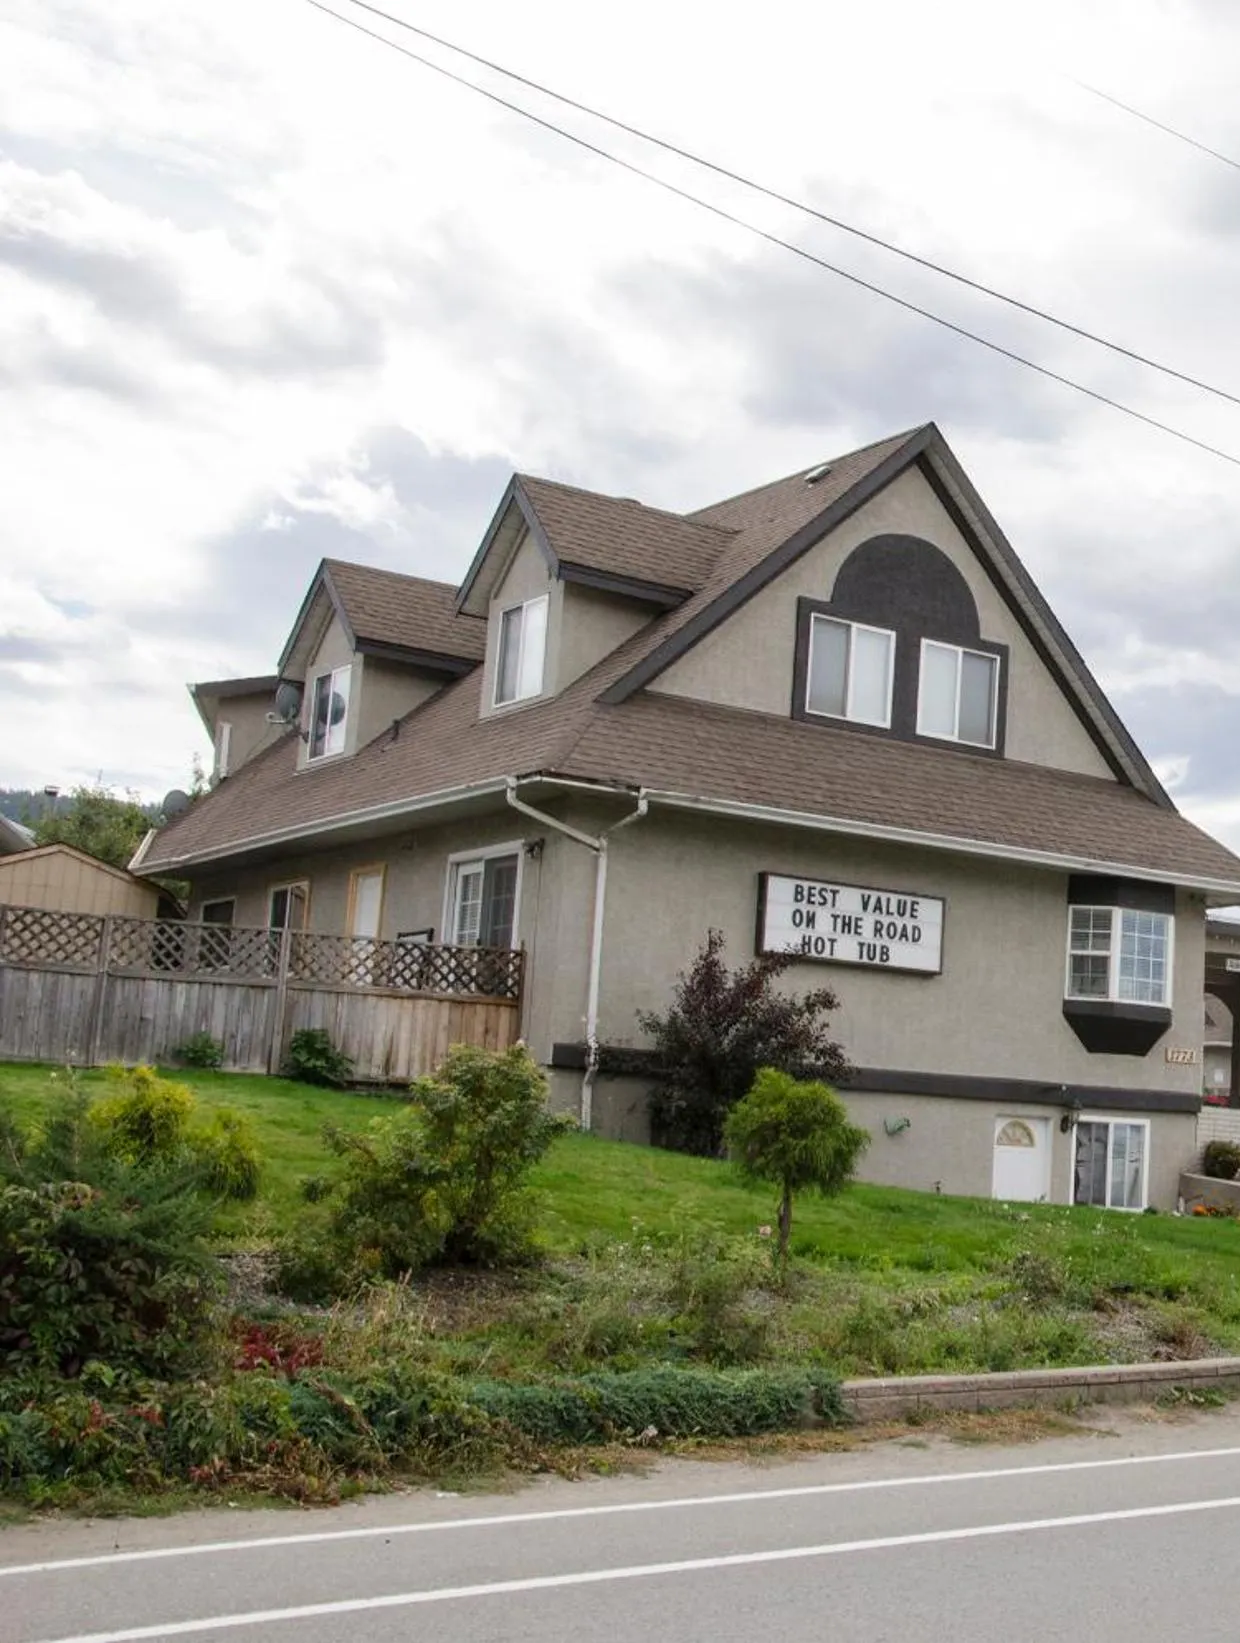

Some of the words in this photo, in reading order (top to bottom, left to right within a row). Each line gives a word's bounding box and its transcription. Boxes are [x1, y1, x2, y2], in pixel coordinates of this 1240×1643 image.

[793, 884, 840, 908] BEST
[860, 893, 920, 919] VALUE
[792, 909, 816, 930] ON
[830, 913, 864, 936] THE
[873, 920, 922, 943] ROAD
[801, 934, 838, 957] HOT
[857, 941, 890, 963] TUB
